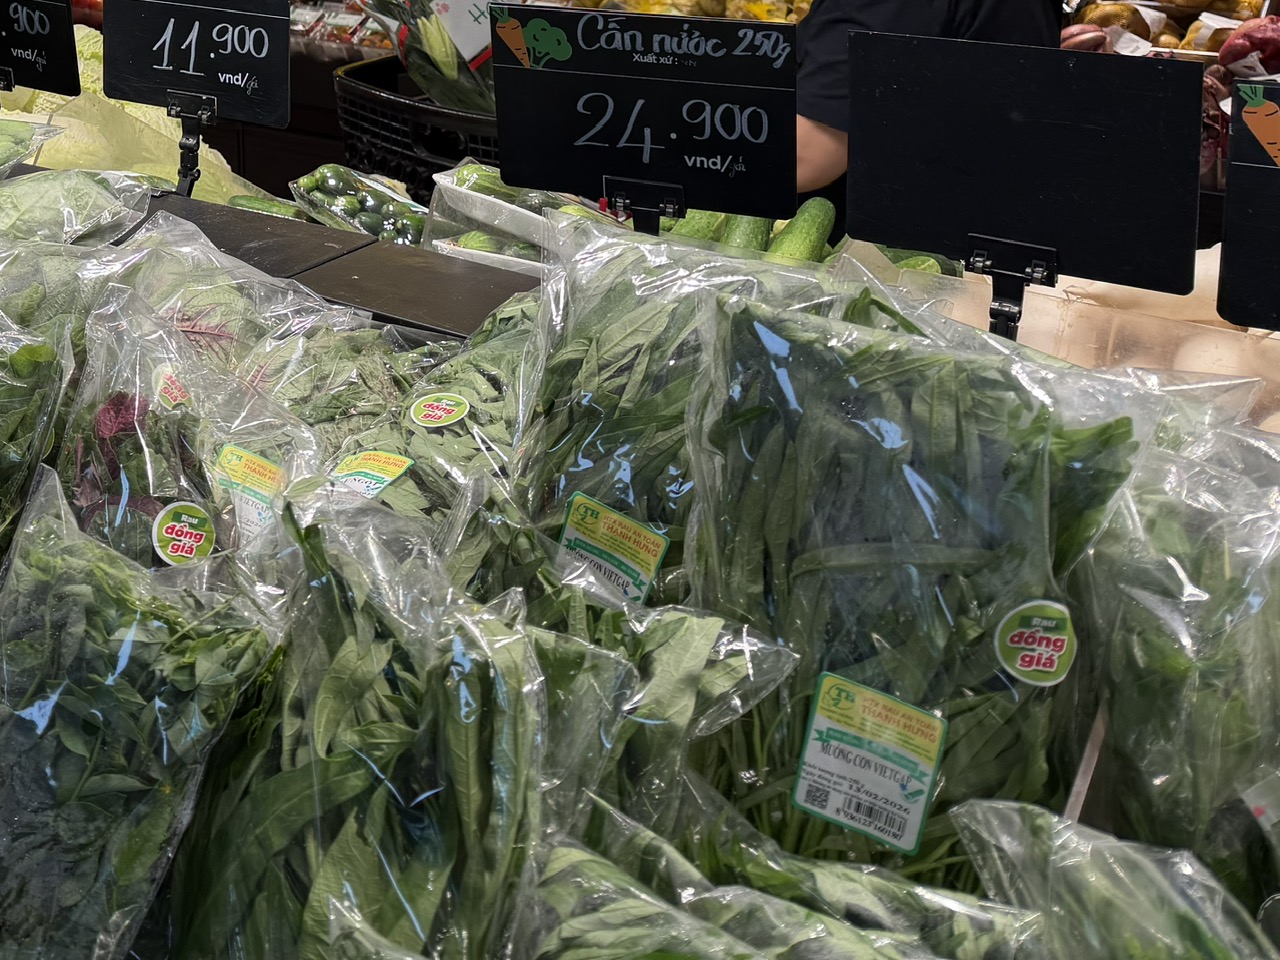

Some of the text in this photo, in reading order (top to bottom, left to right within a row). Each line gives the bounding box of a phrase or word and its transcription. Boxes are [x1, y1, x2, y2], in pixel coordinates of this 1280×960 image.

[152, 18, 269, 76] 11.900
[632, 53, 658, 64] Xuất
[573, 92, 769, 164] 24.900
[422, 402, 455, 415] đồng
[181, 514, 198, 525] Rau
[163, 522, 206, 545] đồng
[168, 539, 196, 558] giá
[1031, 618, 1056, 628] Rau
[1007, 627, 1068, 656] đồng
[1016, 651, 1058, 672] giá
[853, 754, 873, 771] CON
[874, 762, 913, 786] VIETGAP
